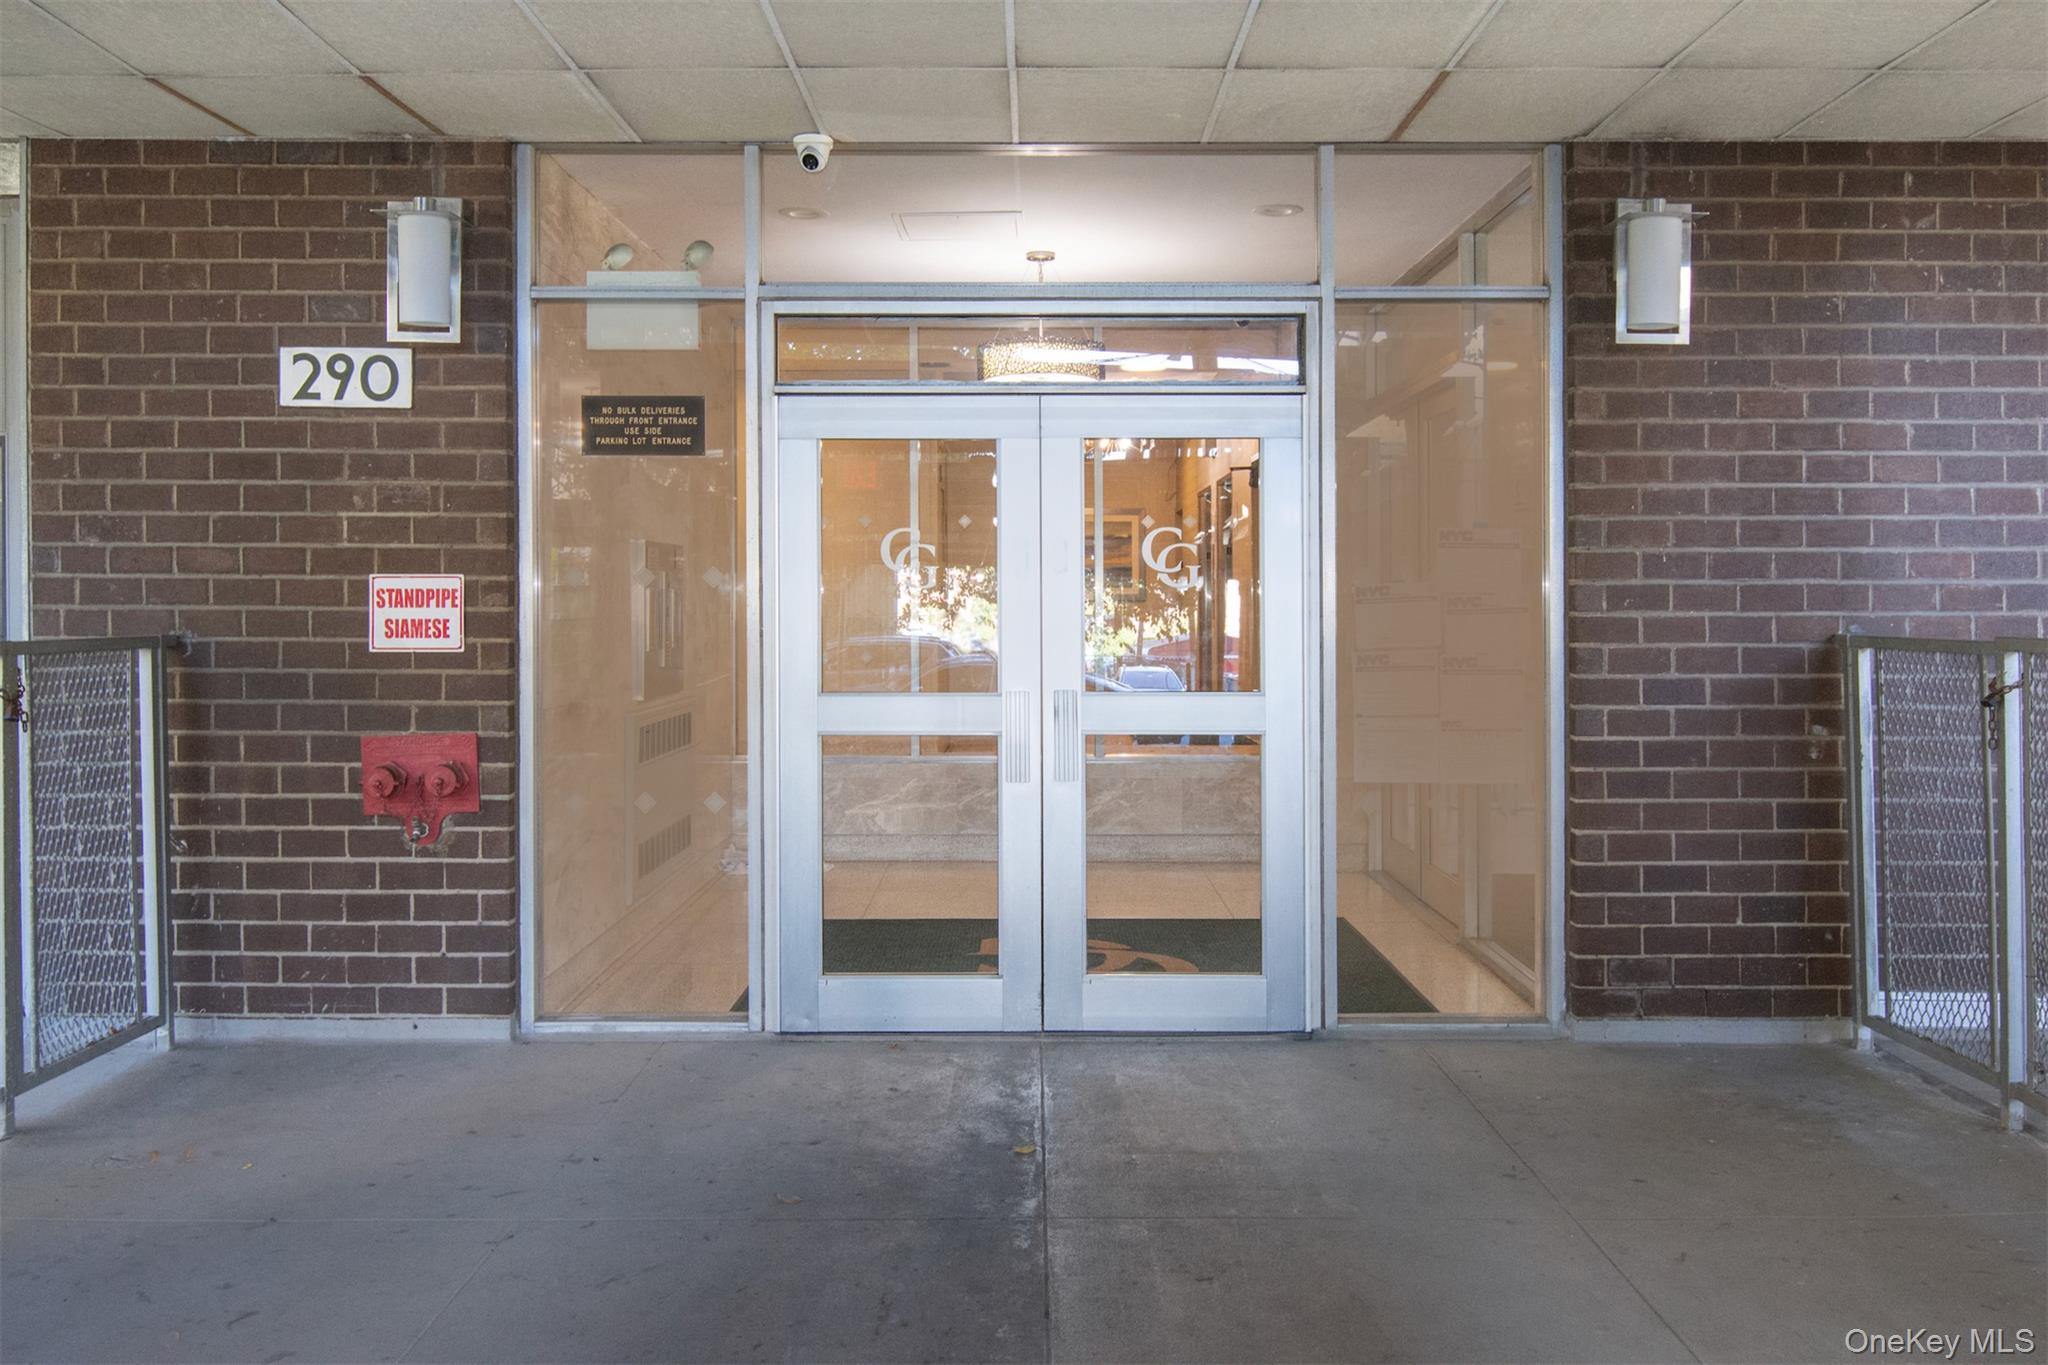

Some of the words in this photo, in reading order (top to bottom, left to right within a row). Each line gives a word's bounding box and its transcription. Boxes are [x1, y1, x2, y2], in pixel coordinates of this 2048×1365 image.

[292, 352, 399, 402] 290
[602, 406, 612, 415] NO
[617, 406, 637, 415] BULK
[640, 406, 686, 415] DELIVERIES
[590, 416, 625, 425] THROUGH
[629, 416, 654, 425] FRONT
[658, 416, 698, 425] ENTRANCE
[624, 426, 640, 435] USE
[644, 426, 662, 435] SIDE
[595, 437, 629, 445] PARKING
[632, 437, 647, 445] LOT
[652, 437, 692, 445] ENTRANCE
[376, 587, 459, 609] STANDPIPE
[384, 618, 450, 640] SIAMESE
